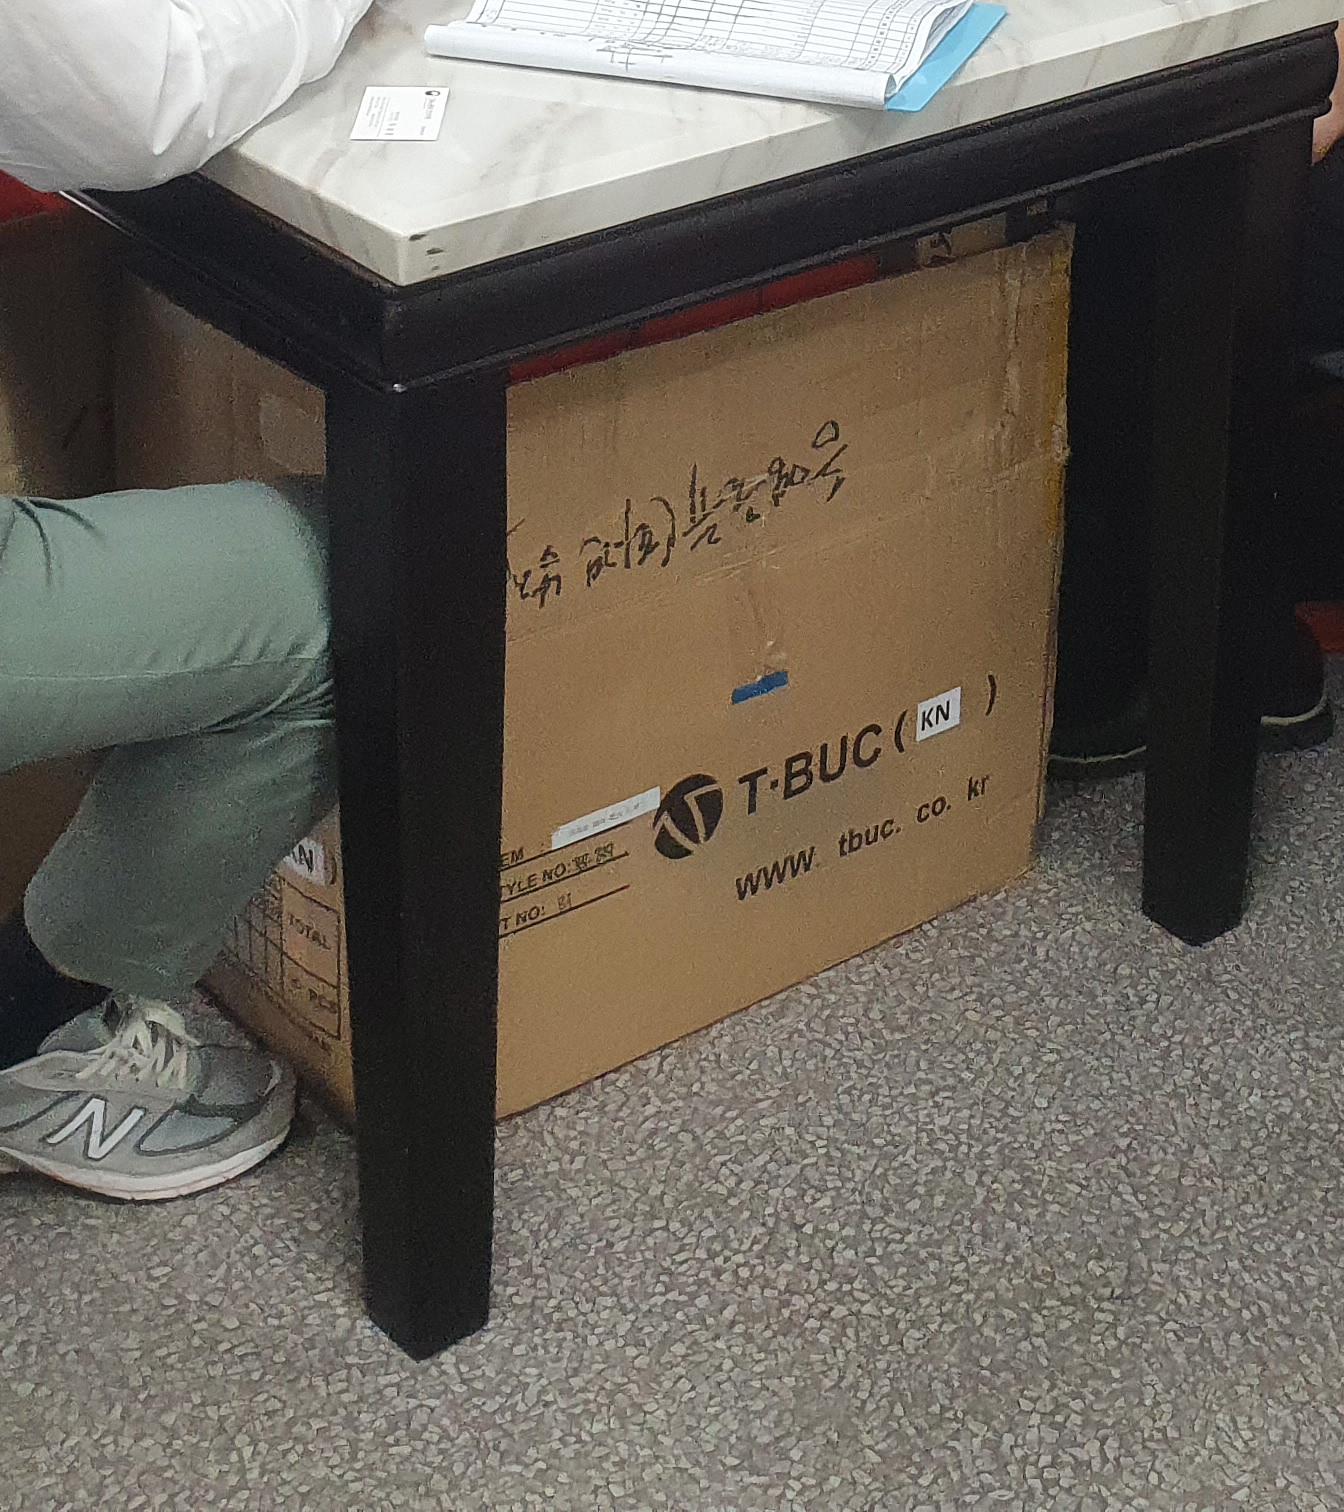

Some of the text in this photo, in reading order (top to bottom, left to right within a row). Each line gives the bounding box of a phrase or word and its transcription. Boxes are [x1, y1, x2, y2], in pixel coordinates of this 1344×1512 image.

[920, 699, 951, 732] KN
[967, 774, 991, 802] kr
[47, 1096, 144, 1161] N
